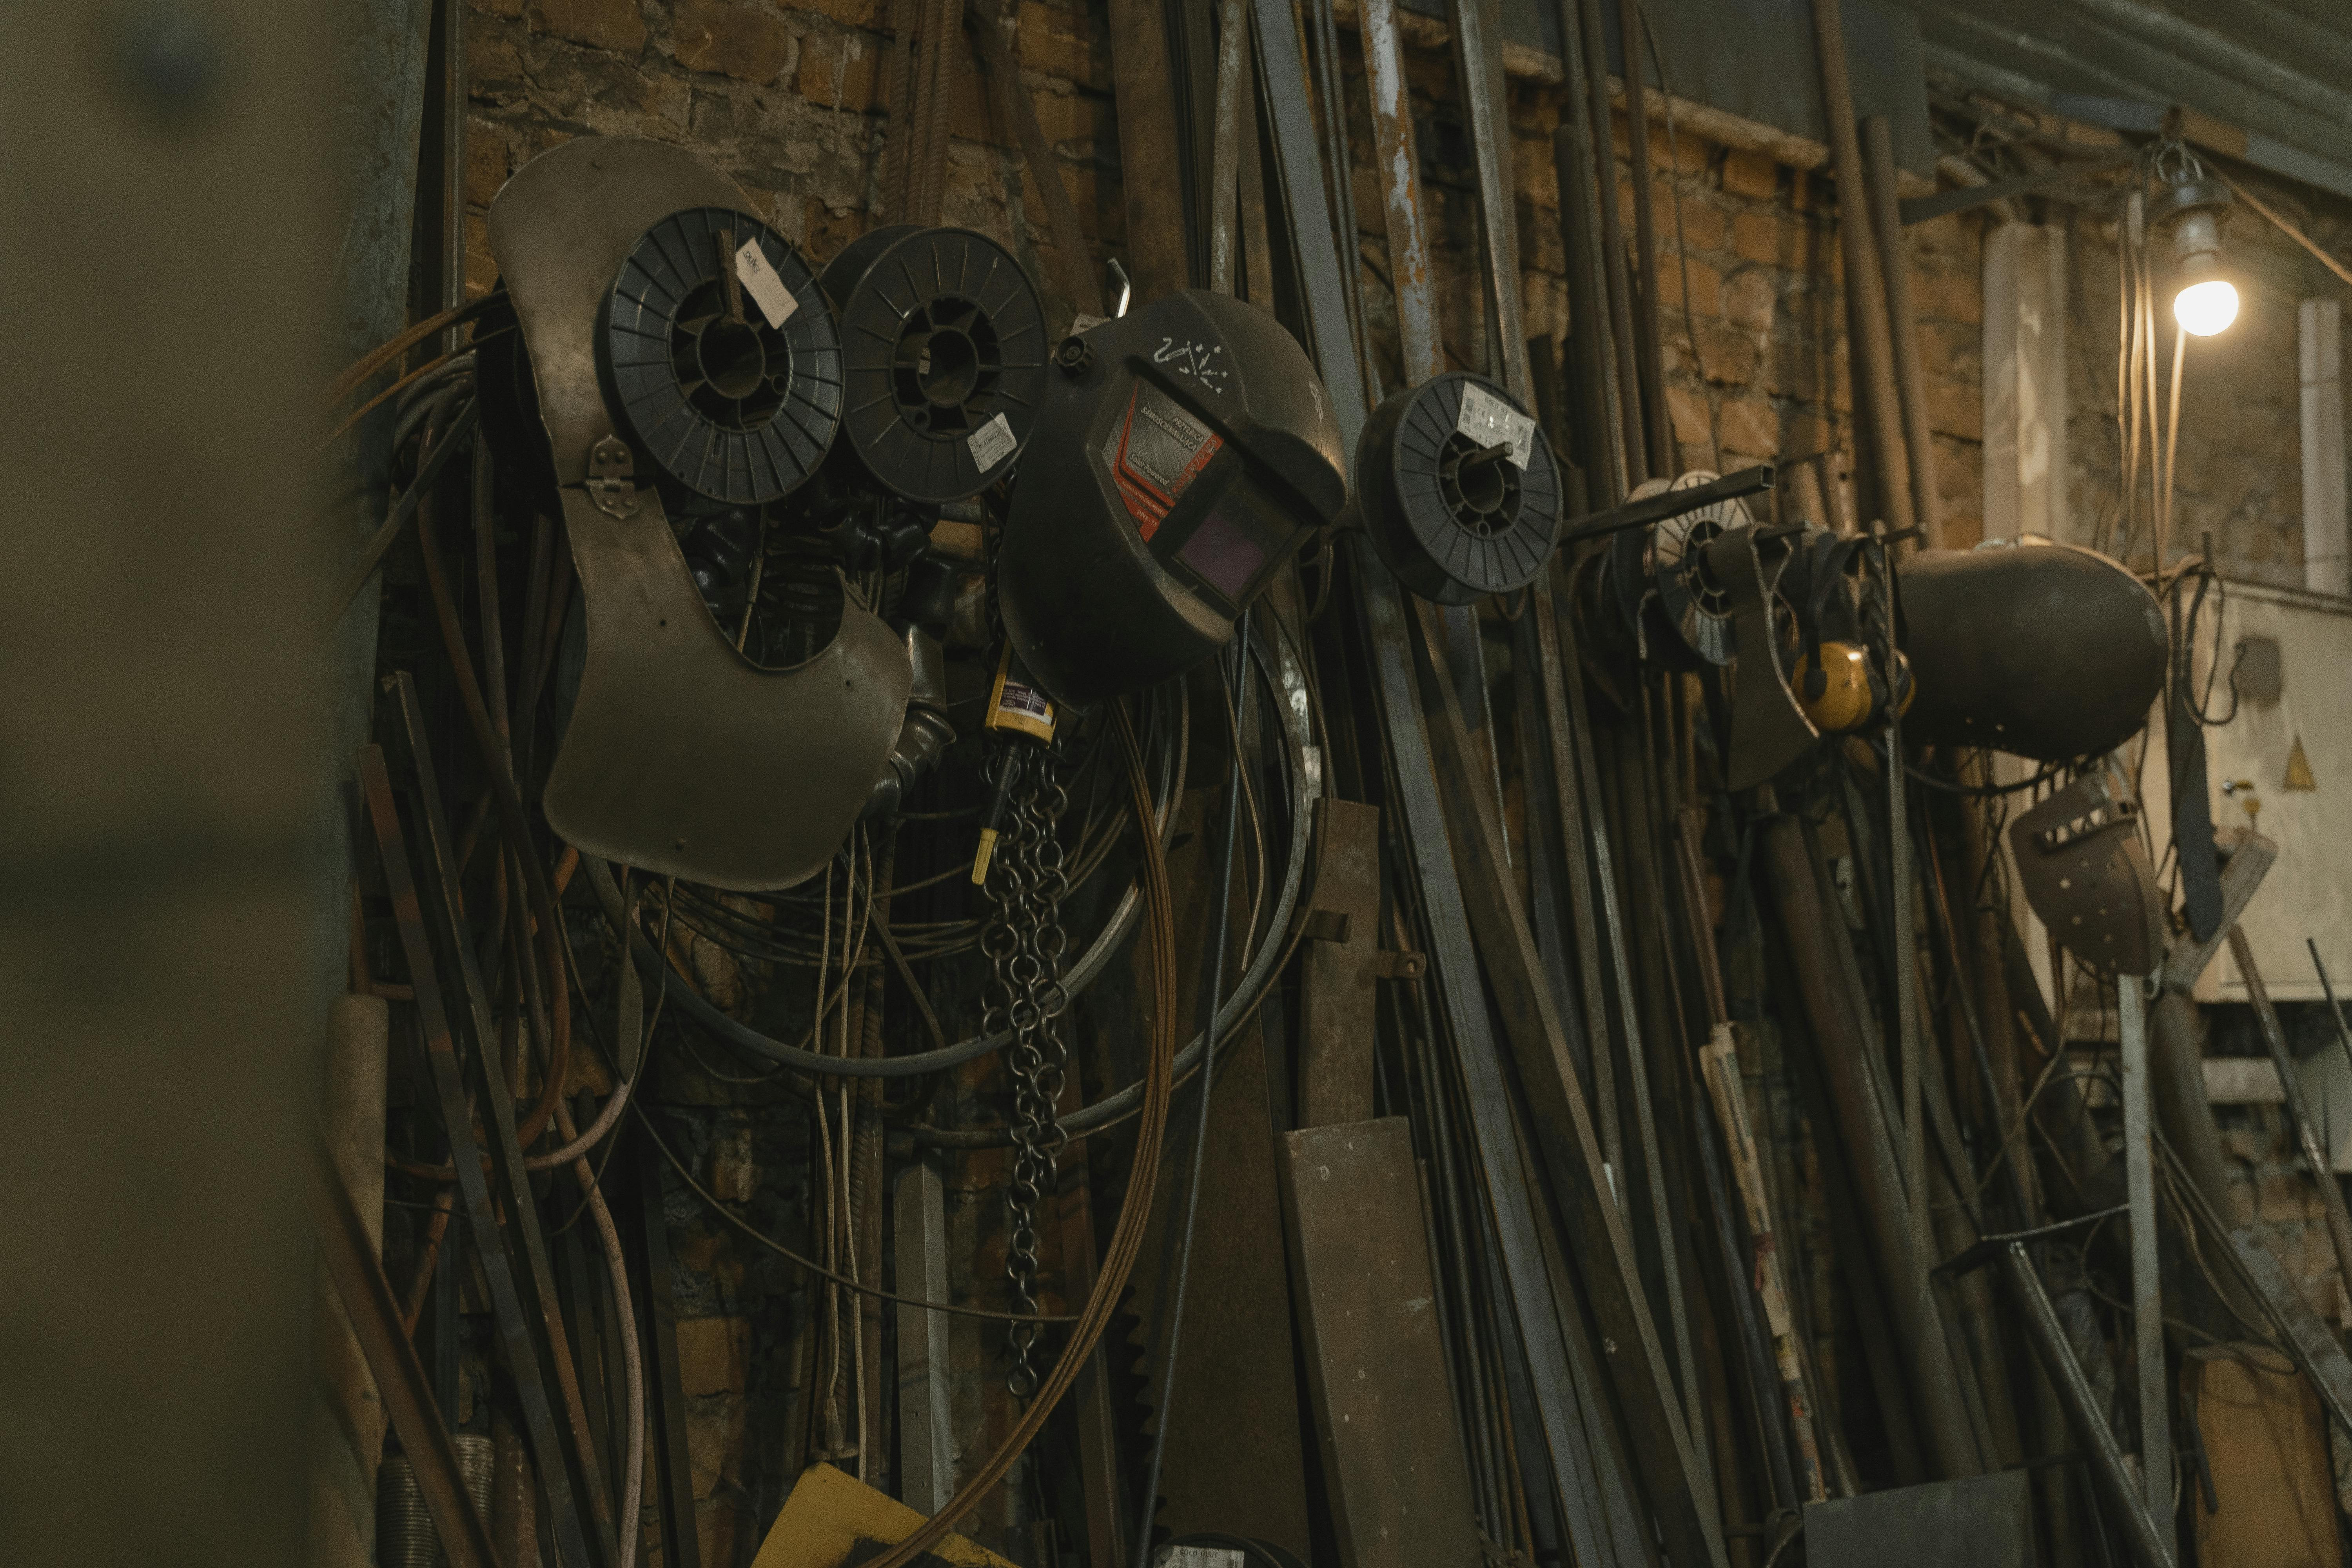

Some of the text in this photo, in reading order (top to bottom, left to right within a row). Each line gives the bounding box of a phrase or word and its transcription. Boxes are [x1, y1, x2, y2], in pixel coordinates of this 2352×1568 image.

[1141, 407, 1197, 452] SAMOŚCIEMNIAJĄCA
[1130, 453, 1170, 486] Solar Powered
